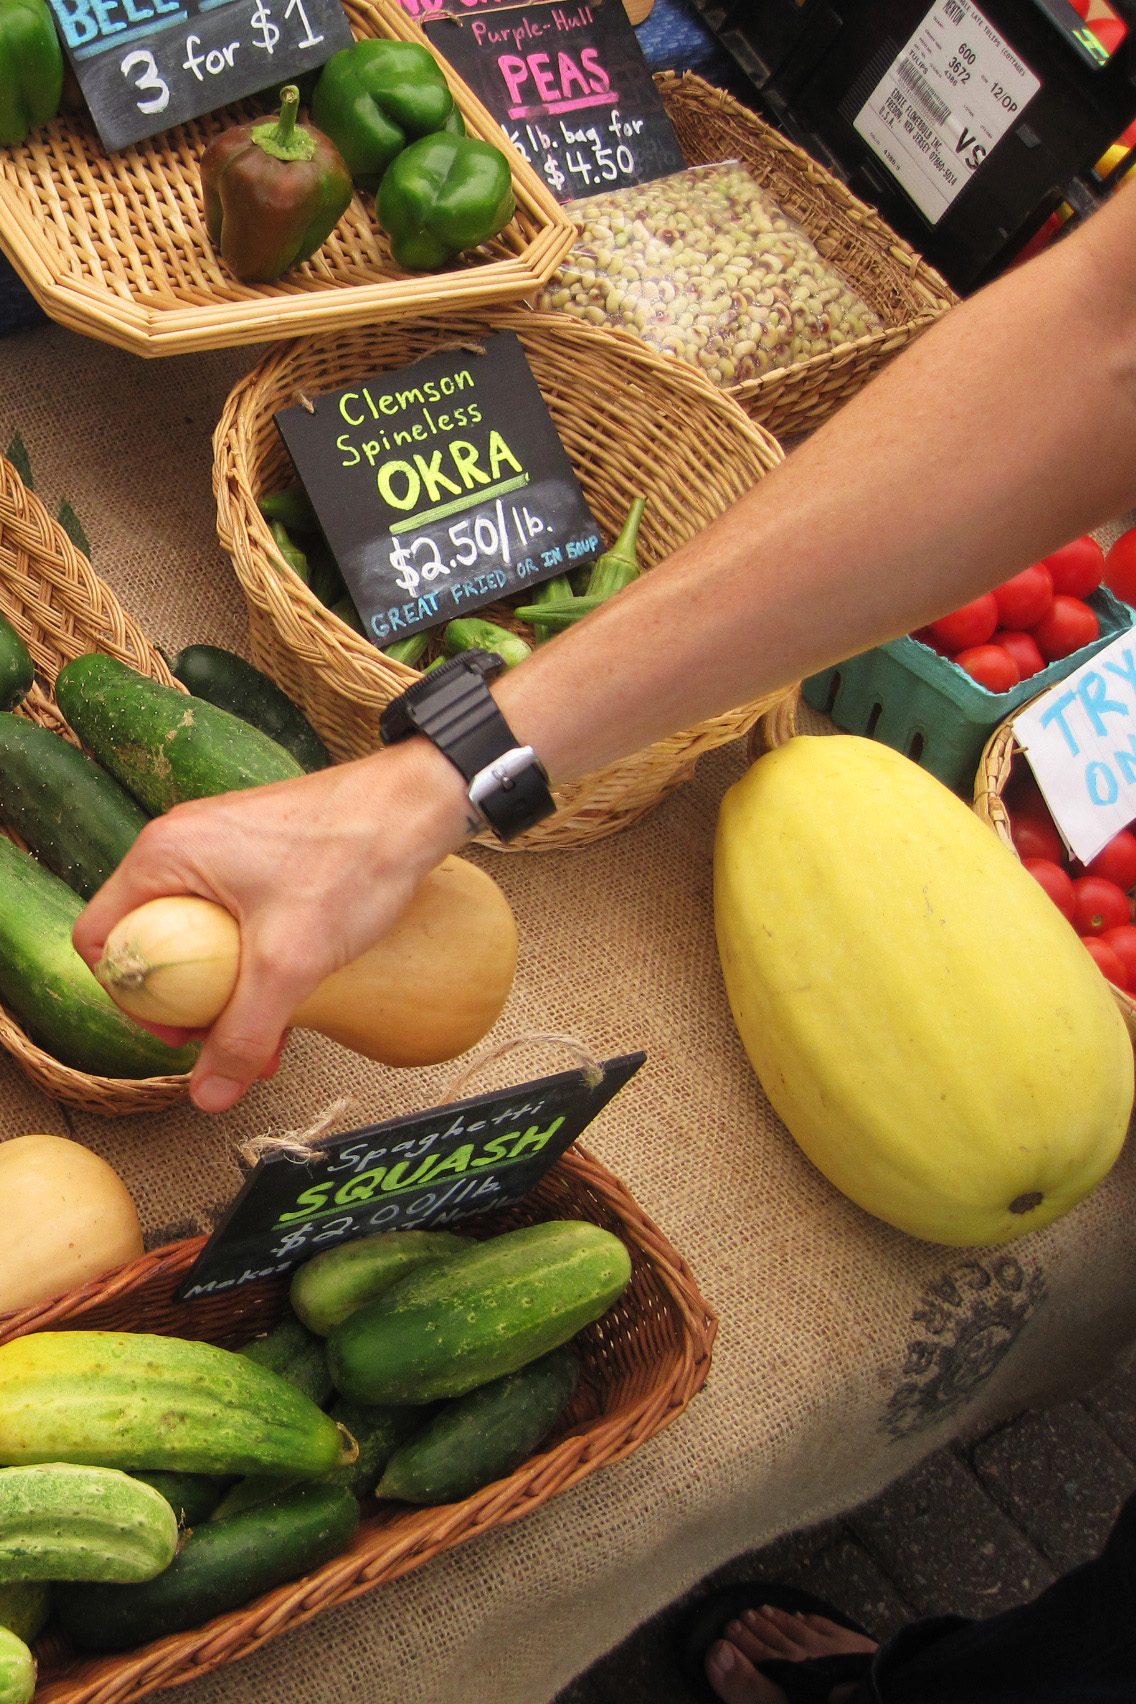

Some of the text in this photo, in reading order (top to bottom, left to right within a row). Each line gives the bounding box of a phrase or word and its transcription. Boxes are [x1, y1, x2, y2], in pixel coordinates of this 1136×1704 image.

[120, 0, 324, 115] 3 for $1
[497, 48, 611, 104] PEAS
[909, 49, 929, 75] TULIPS
[948, 56, 971, 85] 3672
[958, 43, 977, 65] 600
[990, 81, 1018, 113] 12/OP
[559, 121, 601, 151] bag
[608, 109, 644, 143] for
[912, 131, 931, 154] JERSEY
[955, 126, 986, 170] VS
[543, 145, 635, 191] $4.50
[339, 370, 475, 426] Clemson
[336, 403, 483, 467] Spineless
[377, 430, 524, 511] OKRA
[389, 499, 554, 598] $2.50/lb.
[370, 534, 601, 638] GREAT FRIED OR IN SOUP
[327, 1100, 545, 1172] Spaghetti
[279, 1116, 566, 1223] SQUASH
[270, 1176, 501, 1257] $2.00/lb.
[184, 1261, 293, 1298] Makes
